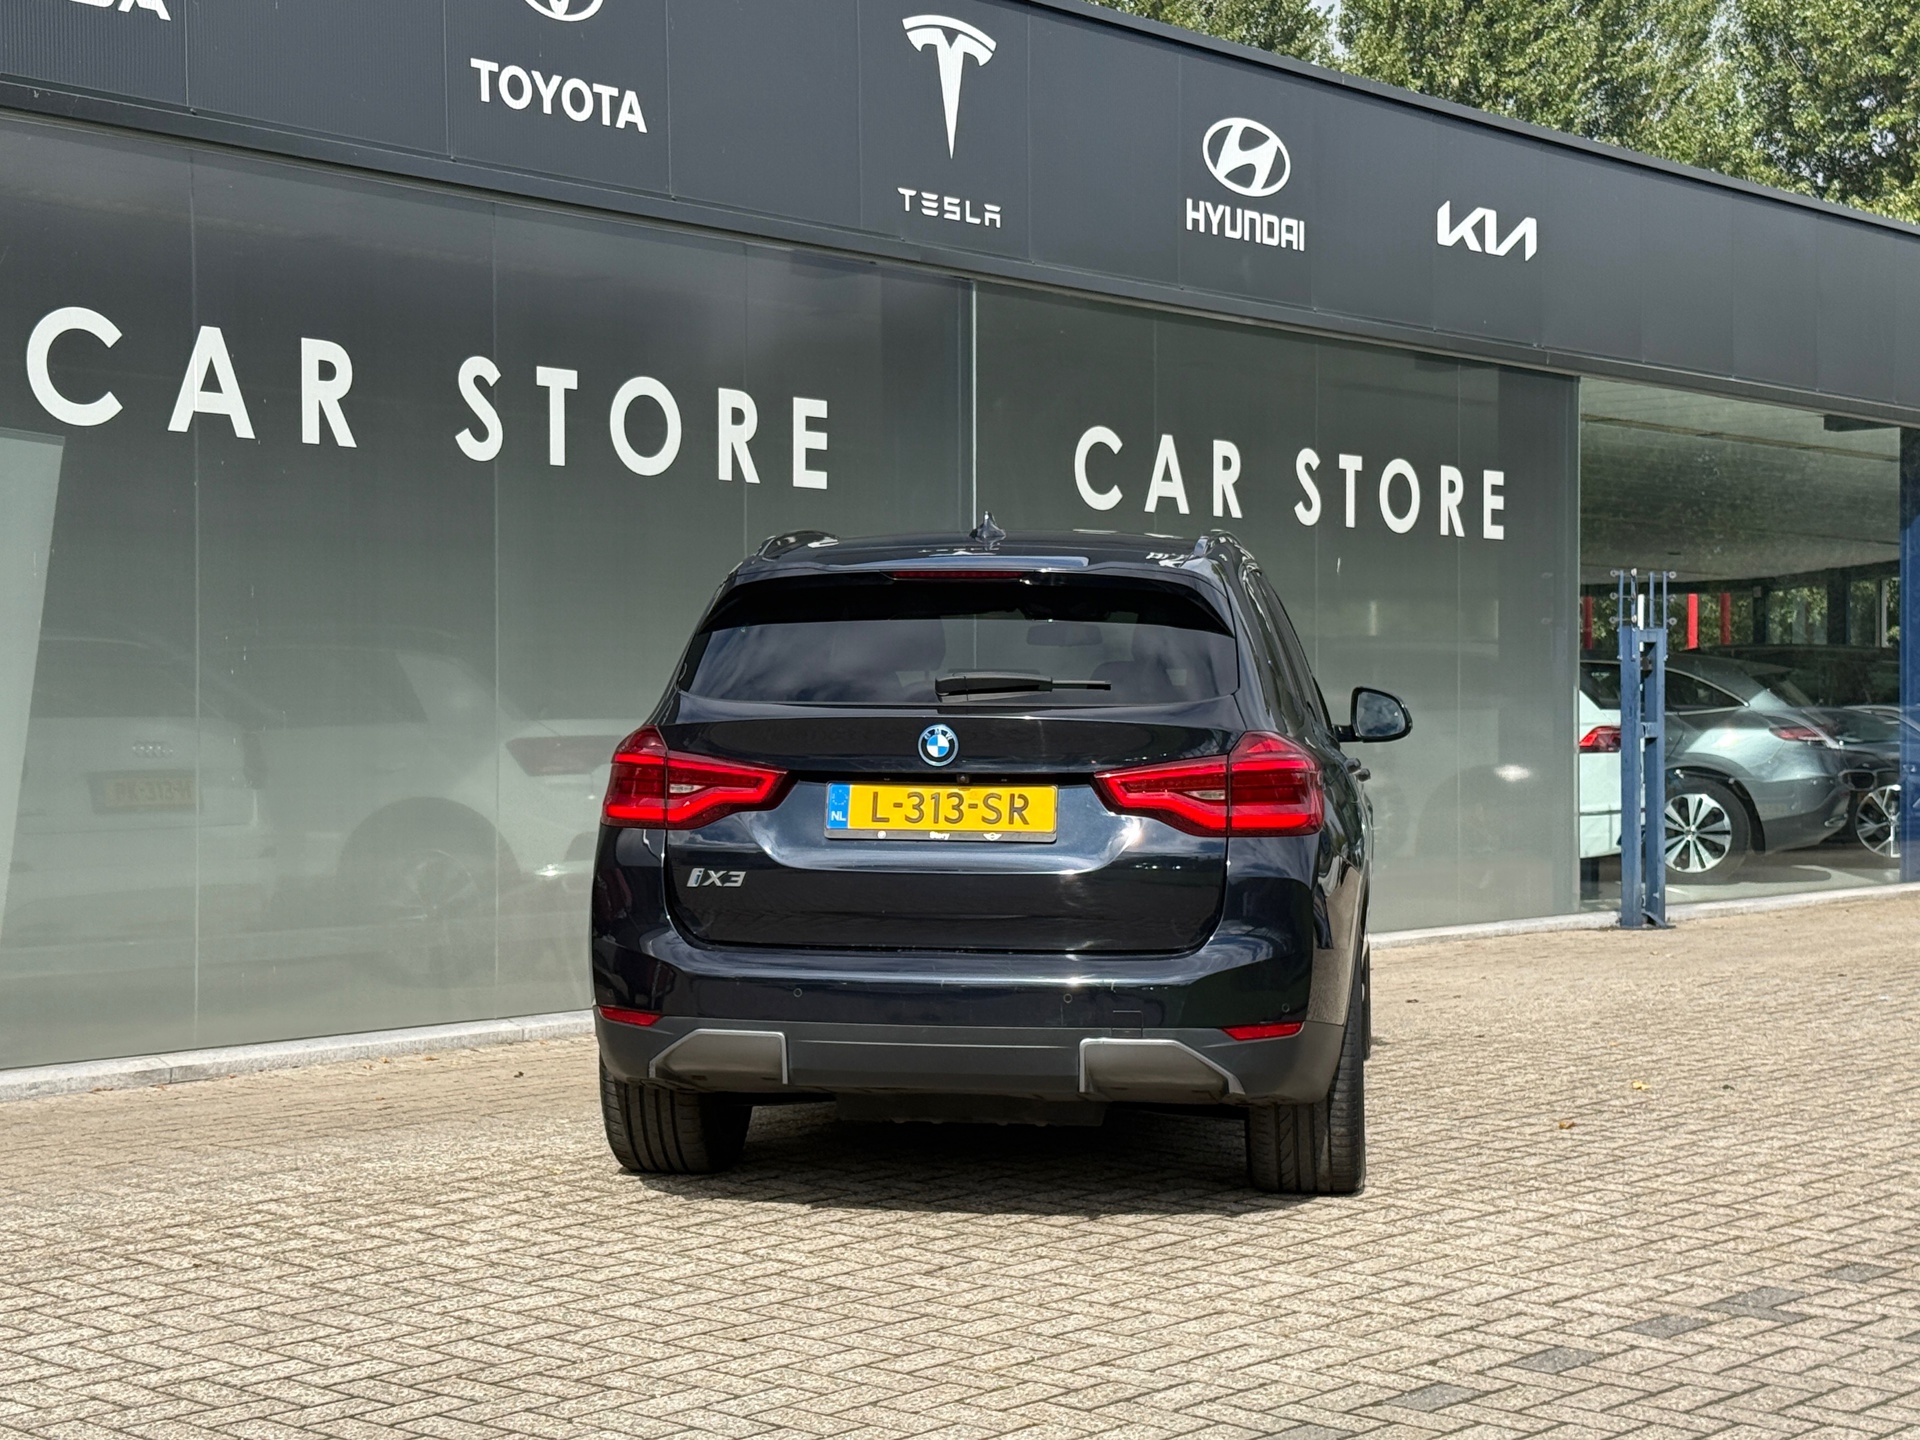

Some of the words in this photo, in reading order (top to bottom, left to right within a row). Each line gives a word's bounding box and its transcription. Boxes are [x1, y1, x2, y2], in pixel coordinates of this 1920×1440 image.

[471, 58, 647, 133] TOYOTA
[898, 187, 1002, 229] TESLA
[1185, 197, 1305, 252] HYUNDAI
[1436, 200, 1538, 262] KIA
[26, 306, 357, 448] CAR
[455, 355, 829, 490] STORE
[1074, 425, 1243, 519] CAR
[1294, 447, 1505, 540] STORE
[831, 810, 847, 822] NL
[871, 791, 1030, 826] L-313-SR
[686, 867, 747, 888] iX3
